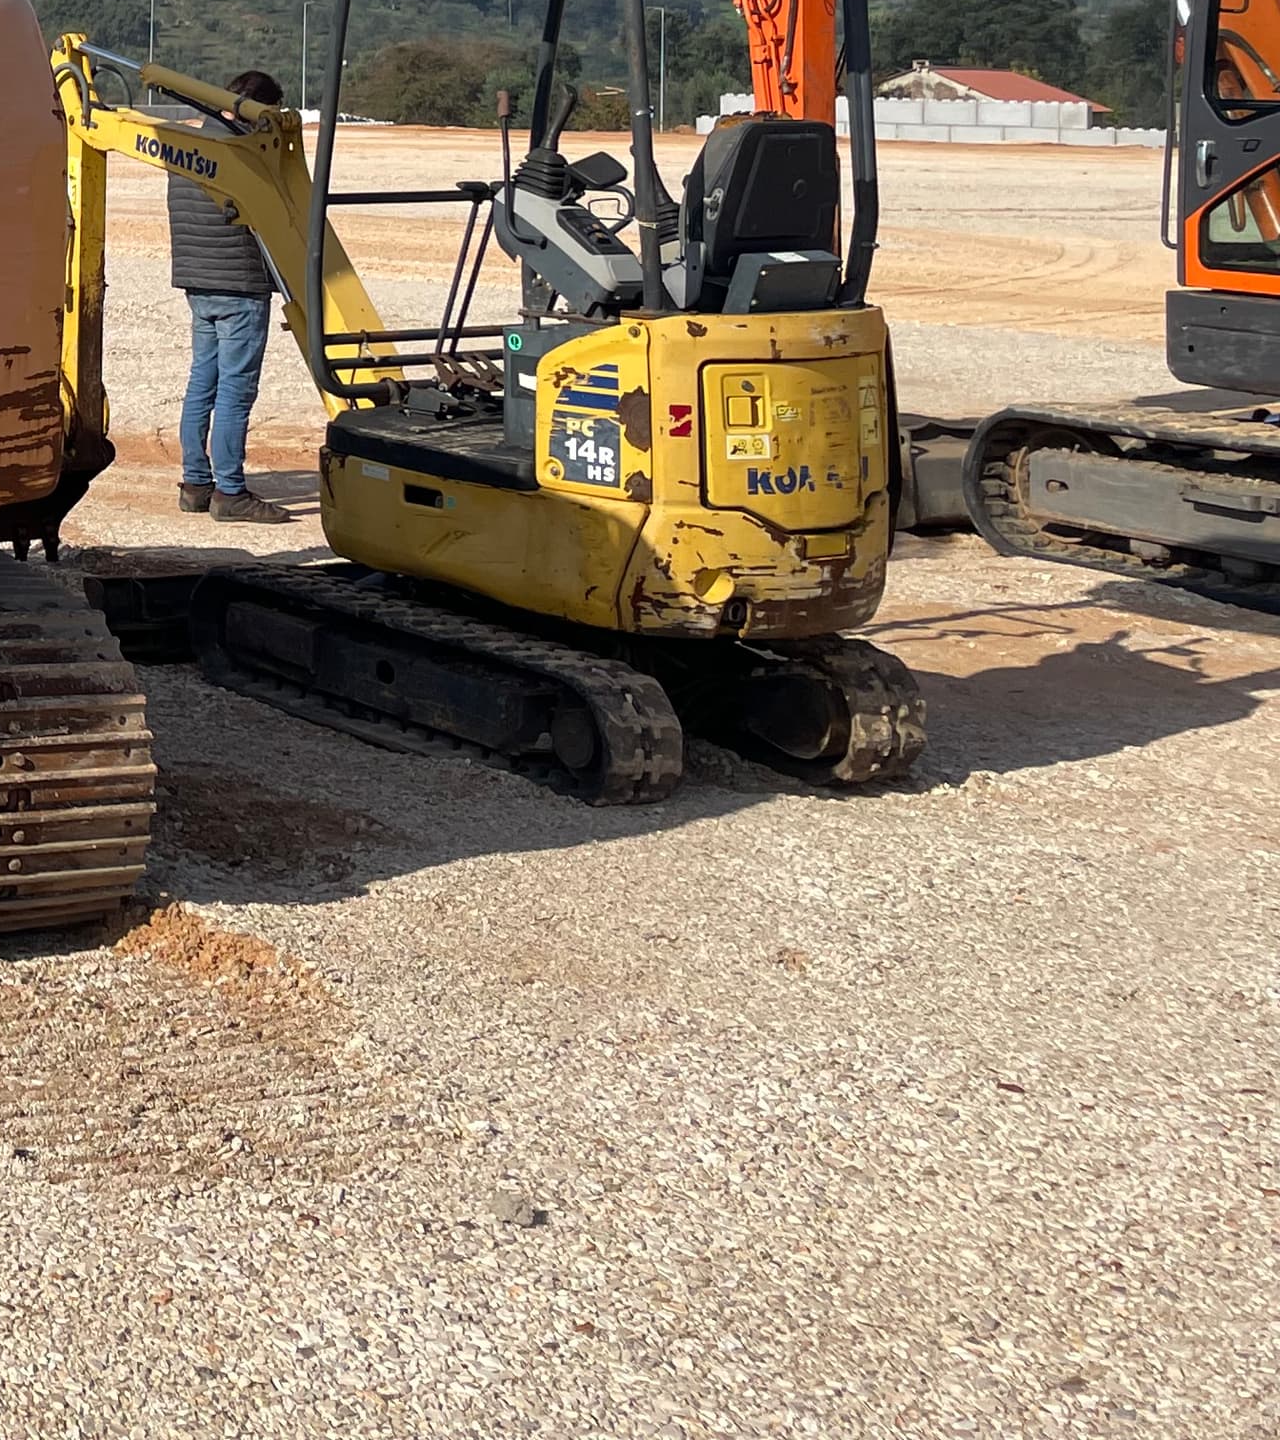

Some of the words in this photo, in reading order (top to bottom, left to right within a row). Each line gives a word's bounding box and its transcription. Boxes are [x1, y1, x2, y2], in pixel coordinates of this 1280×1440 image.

[135, 133, 218, 179] KOMATSU
[565, 417, 594, 438] PC
[564, 437, 616, 466] 14R
[587, 464, 616, 482] HS
